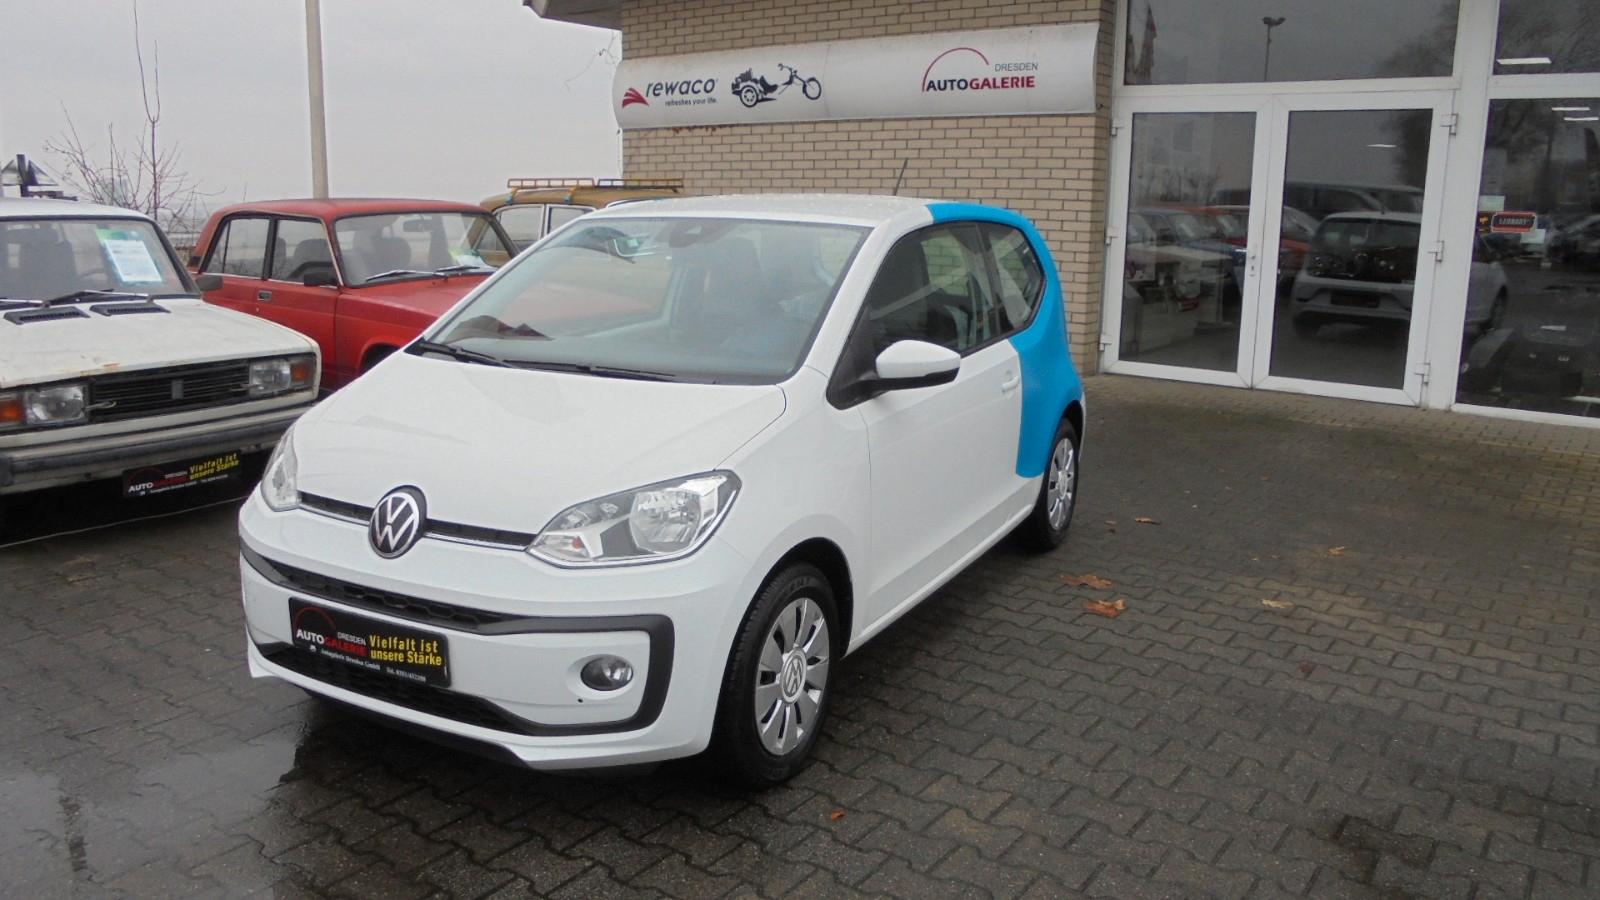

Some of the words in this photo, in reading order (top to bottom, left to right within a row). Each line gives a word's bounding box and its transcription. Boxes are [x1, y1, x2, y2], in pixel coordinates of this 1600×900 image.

[994, 62, 1038, 72] DRESDEN
[645, 78, 716, 97] rewaco
[926, 76, 1035, 91] AUTOGALERIE
[692, 98, 706, 106] your
[337, 632, 366, 646] DRESDEN
[369, 635, 416, 651] Vielfalt
[420, 639, 438, 653] ist
[370, 650, 404, 663] unsere
[407, 652, 442, 666] Stärke
